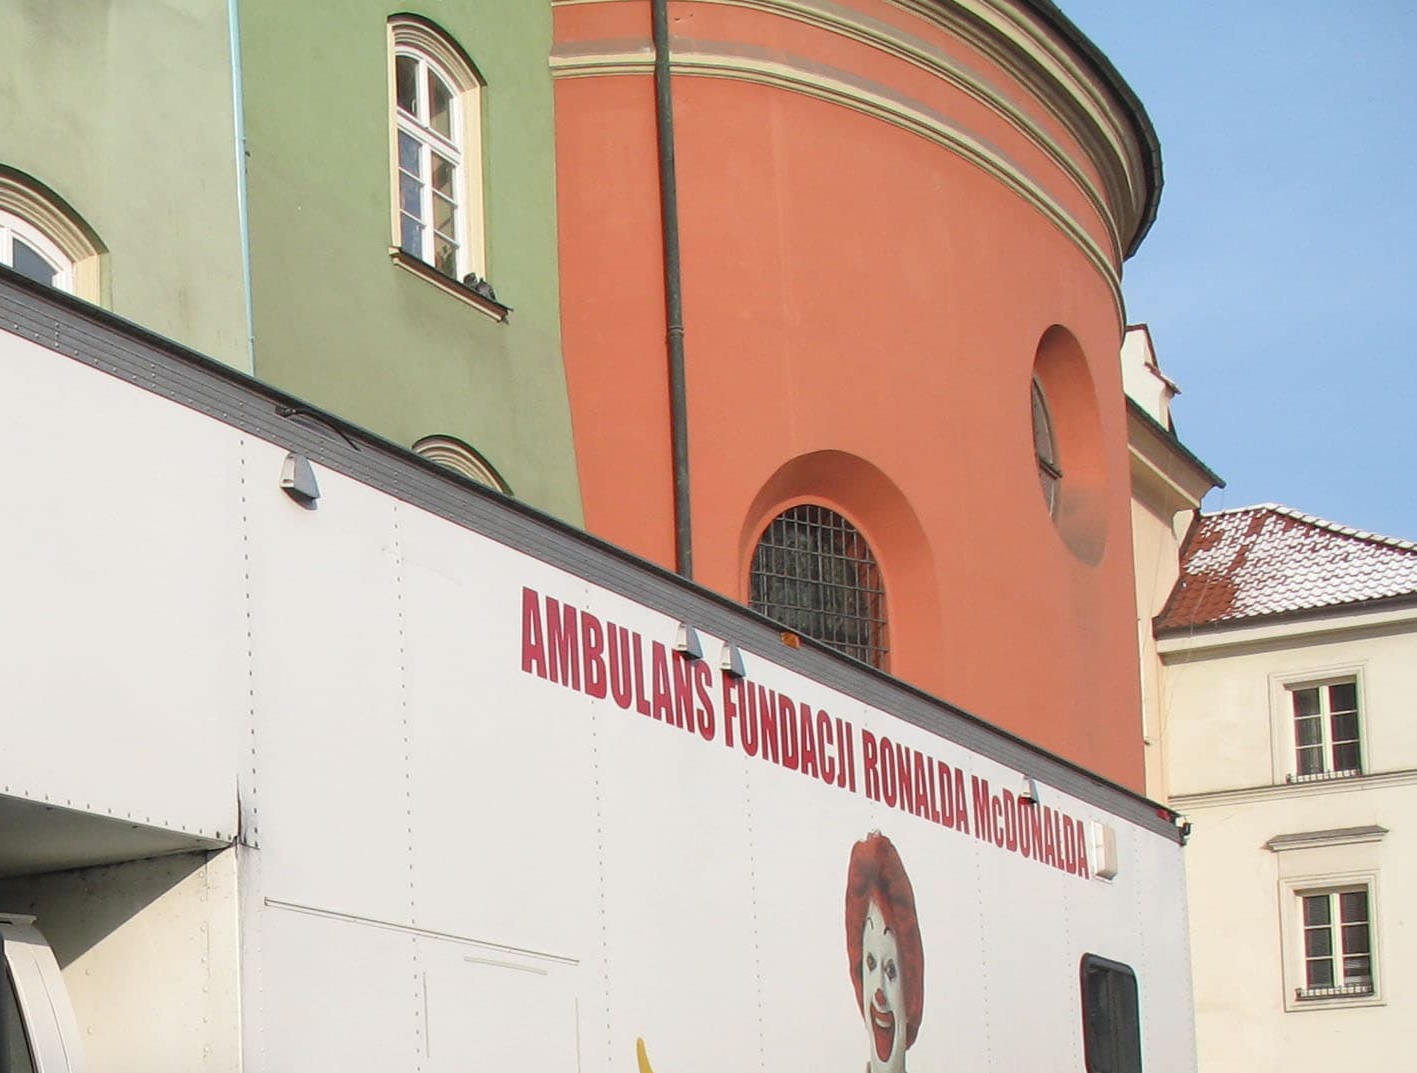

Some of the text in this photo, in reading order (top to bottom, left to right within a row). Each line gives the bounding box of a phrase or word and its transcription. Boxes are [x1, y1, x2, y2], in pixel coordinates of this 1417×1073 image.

[520, 586, 1090, 881] AMBULANS FUNDACJI RONALDA McDONALDA
